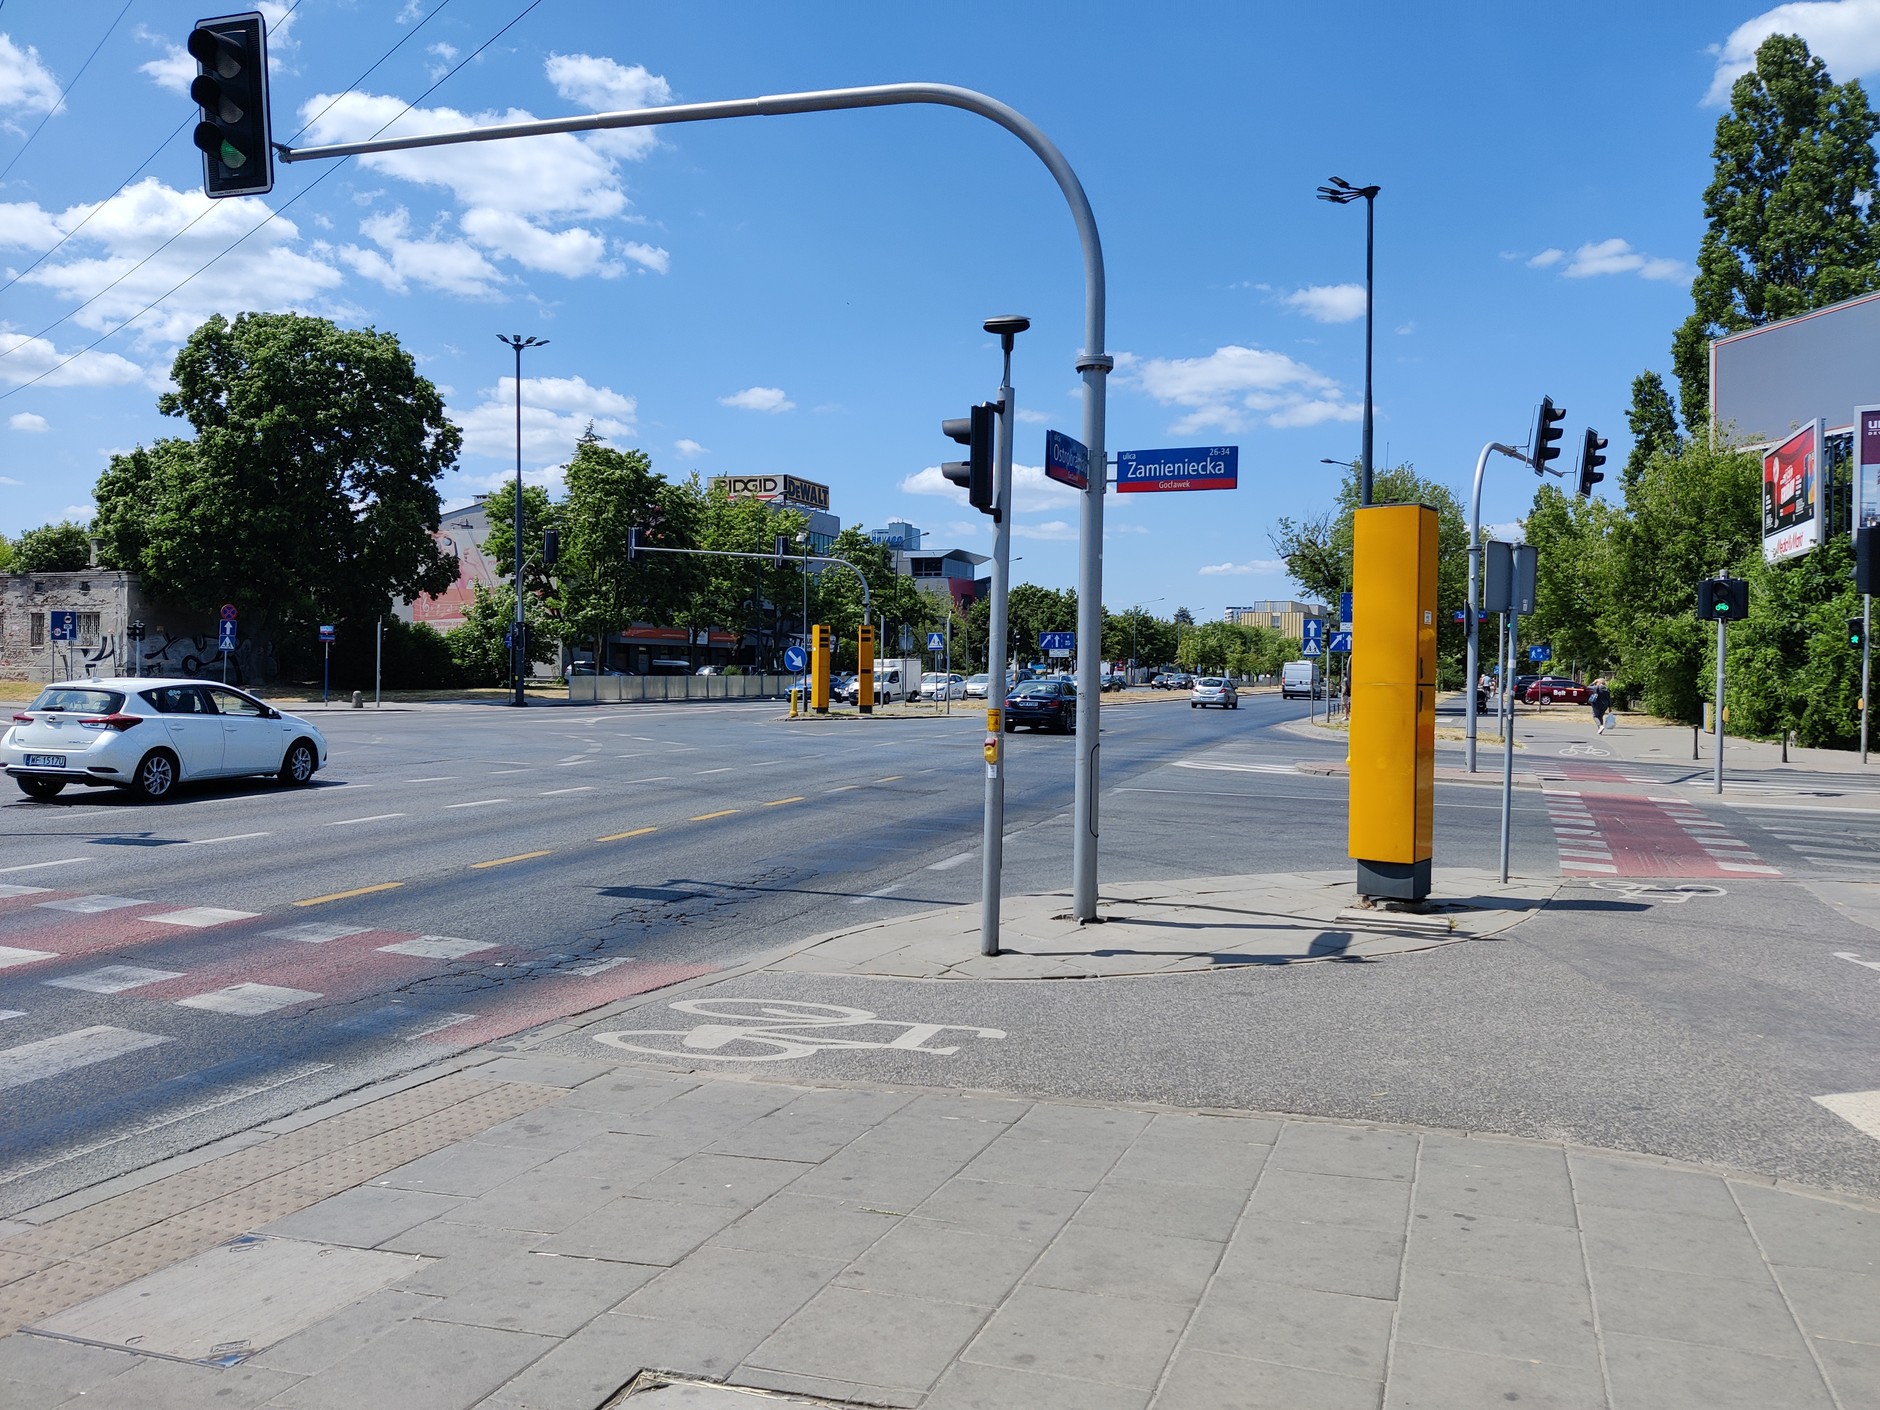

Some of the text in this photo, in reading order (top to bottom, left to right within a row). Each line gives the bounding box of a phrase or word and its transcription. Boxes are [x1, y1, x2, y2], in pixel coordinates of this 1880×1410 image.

[1210, 448, 1230, 456] 26-34
[1128, 458, 1225, 478] Zamieniecka
[1158, 480, 1190, 489] Gocławek
